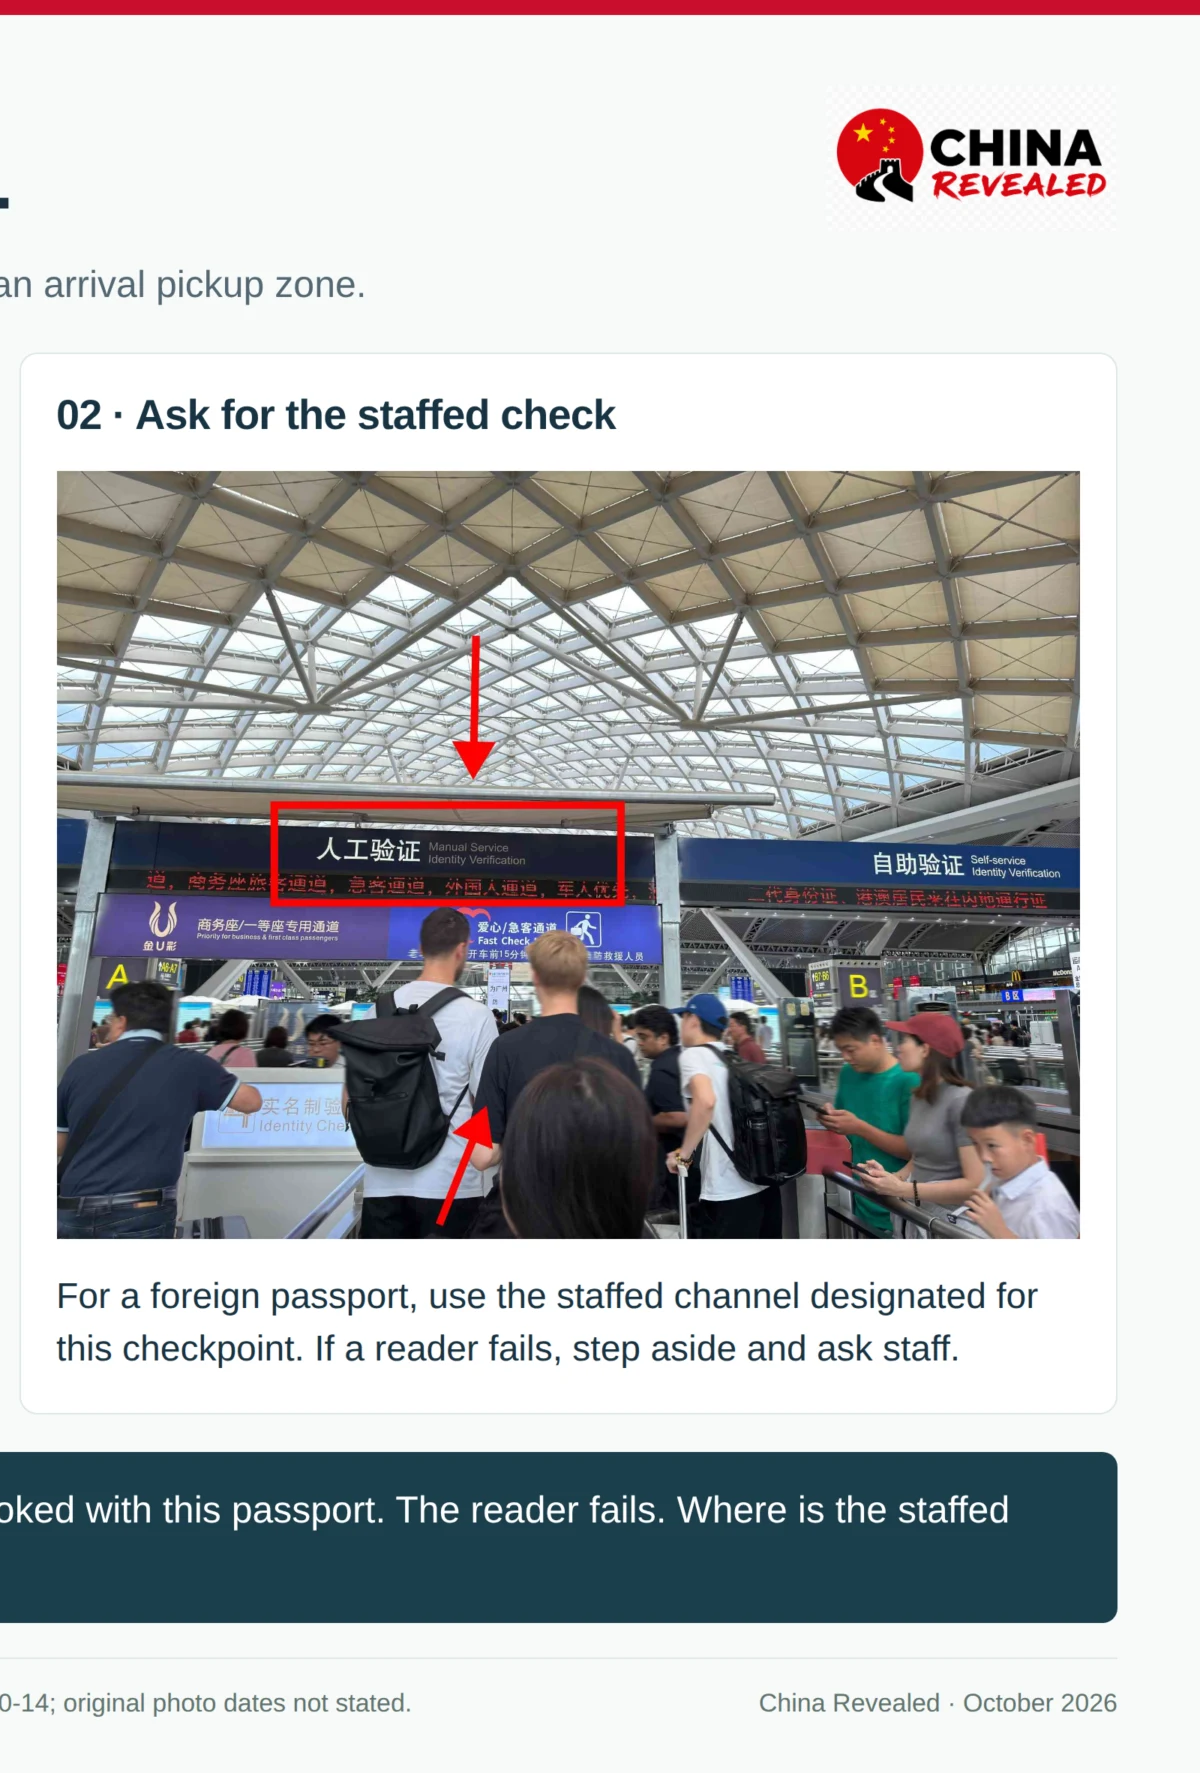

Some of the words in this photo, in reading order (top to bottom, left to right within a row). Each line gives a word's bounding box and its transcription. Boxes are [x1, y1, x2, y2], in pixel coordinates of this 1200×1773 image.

[316, 836, 421, 862] 人工验证
[429, 841, 467, 852] Manual
[470, 842, 509, 853] Service
[429, 854, 466, 866] Identity
[469, 855, 526, 866] Verification
[873, 852, 965, 876] 自助验证
[970, 854, 1026, 866] Self-service
[972, 867, 1007, 879] Identity
[1008, 867, 1061, 879] Verification
[197, 918, 340, 933] 商务座/一等座专用通道
[196, 932, 220, 941] Priority
[232, 933, 261, 941] business
[478, 936, 498, 945] Fast
[501, 936, 530, 946] Check
[105, 964, 129, 990] A
[849, 974, 869, 998] B
[260, 1120, 312, 1134] Identity
